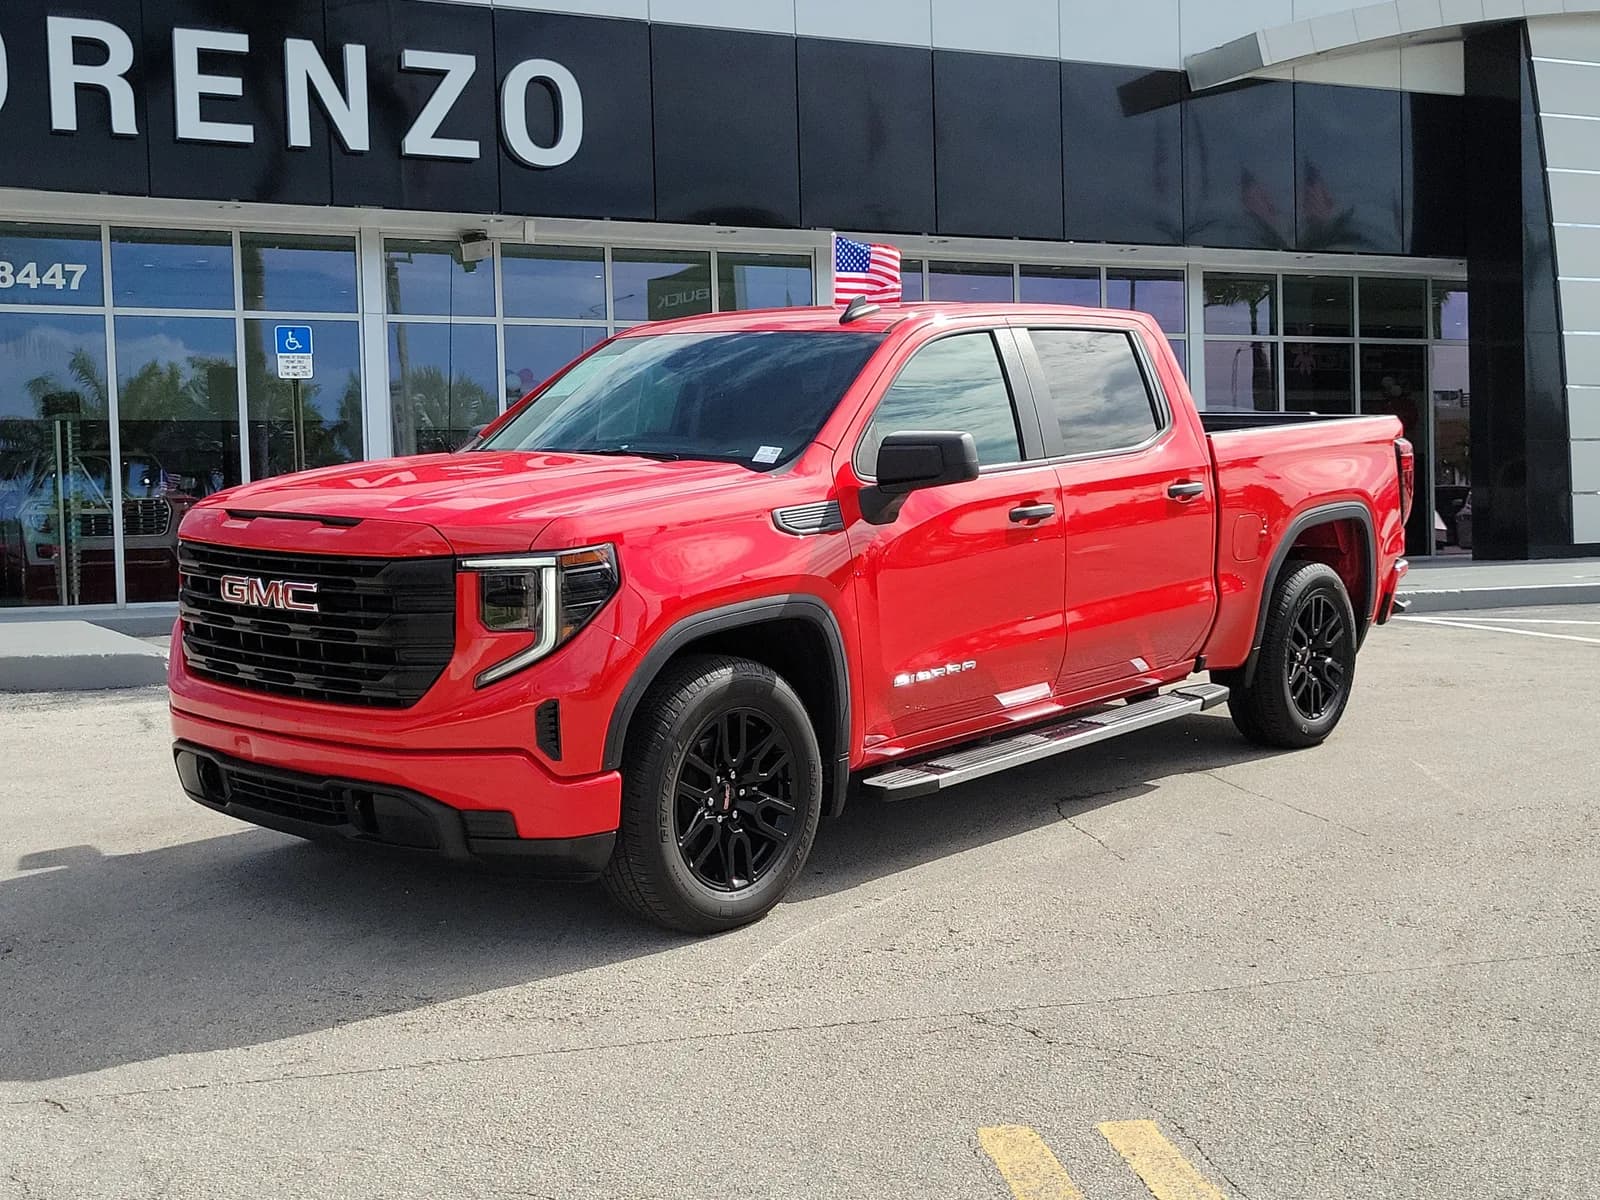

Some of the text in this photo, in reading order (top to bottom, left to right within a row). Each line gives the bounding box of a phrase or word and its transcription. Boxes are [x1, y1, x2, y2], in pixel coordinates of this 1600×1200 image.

[0, 16, 584, 168] RENZO
[0, 261, 88, 290] 8447
[221, 575, 319, 612] GMC
[893, 660, 977, 687] SIERRA
[659, 741, 683, 844] GENERAL
